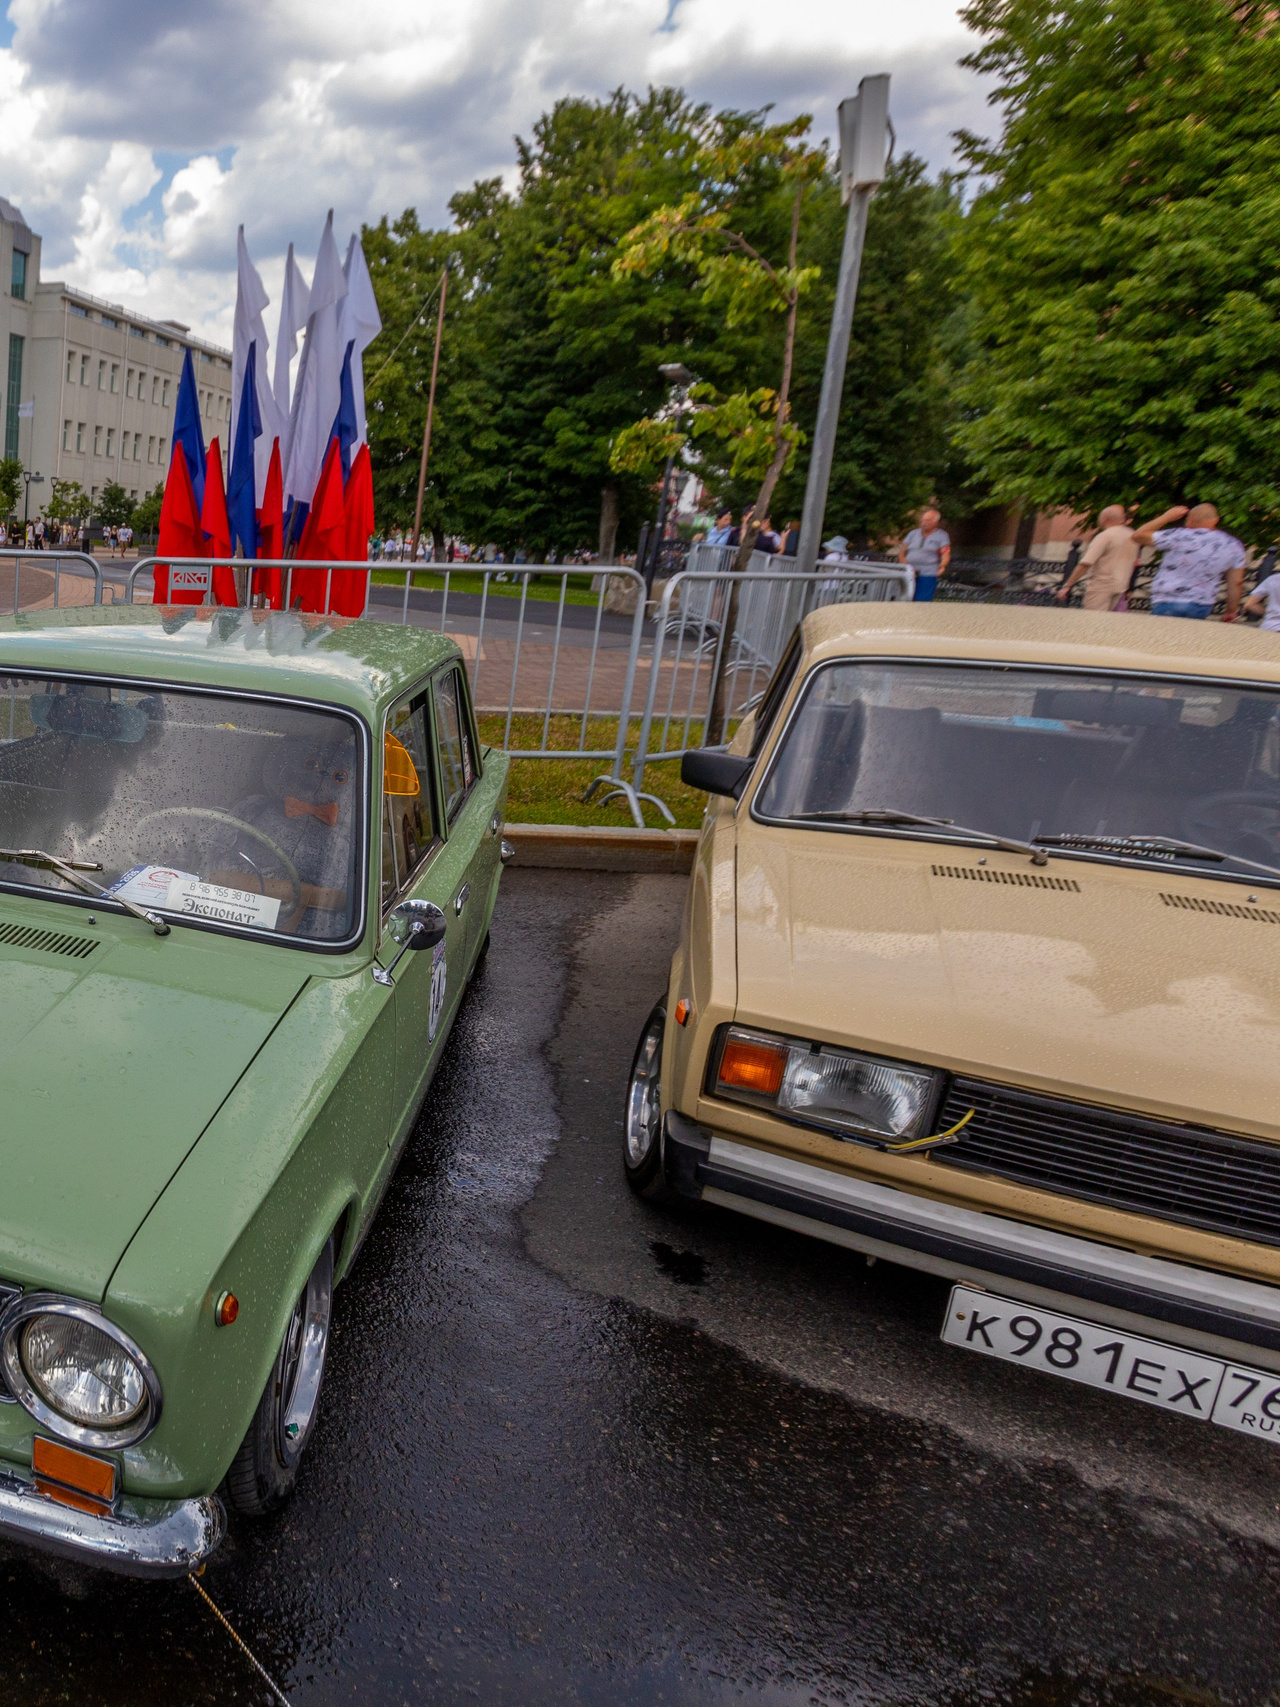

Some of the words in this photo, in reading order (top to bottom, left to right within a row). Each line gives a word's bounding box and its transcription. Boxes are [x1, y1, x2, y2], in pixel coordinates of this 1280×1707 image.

[189, 881, 196, 891] 8
[198, 883, 211, 894] 916
[213, 886, 229, 898] 955
[231, 889, 242, 900] 38
[244, 893, 257, 904] 07
[965, 1309, 1212, 1412] К981ЕХ
[1241, 1412, 1280, 1436] RU
